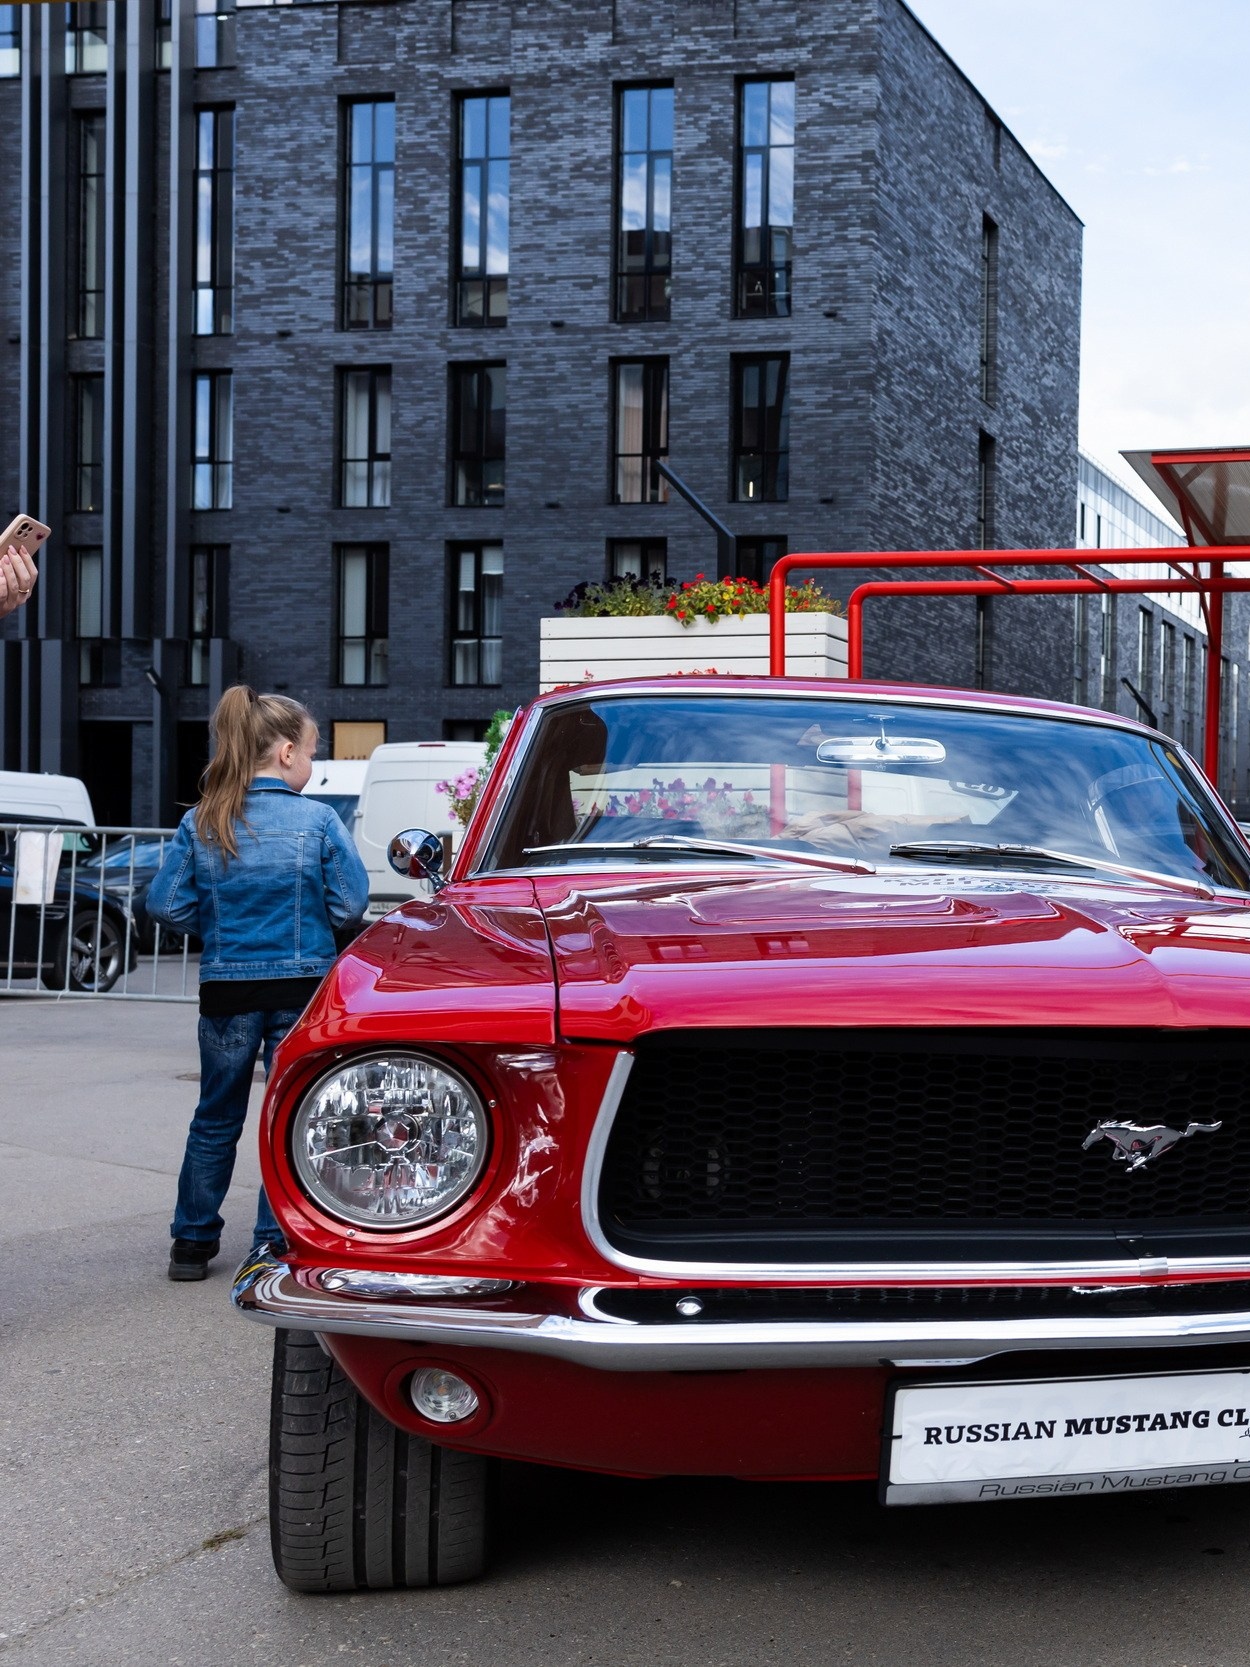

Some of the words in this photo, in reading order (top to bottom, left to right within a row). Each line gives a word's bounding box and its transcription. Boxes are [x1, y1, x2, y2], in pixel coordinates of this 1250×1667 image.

[923, 1419, 1057, 1445] RUSSIAN
[1063, 1409, 1211, 1438] MUSTANG
[978, 1479, 1096, 1498] Russian
[1101, 1469, 1227, 1489] Mustang
